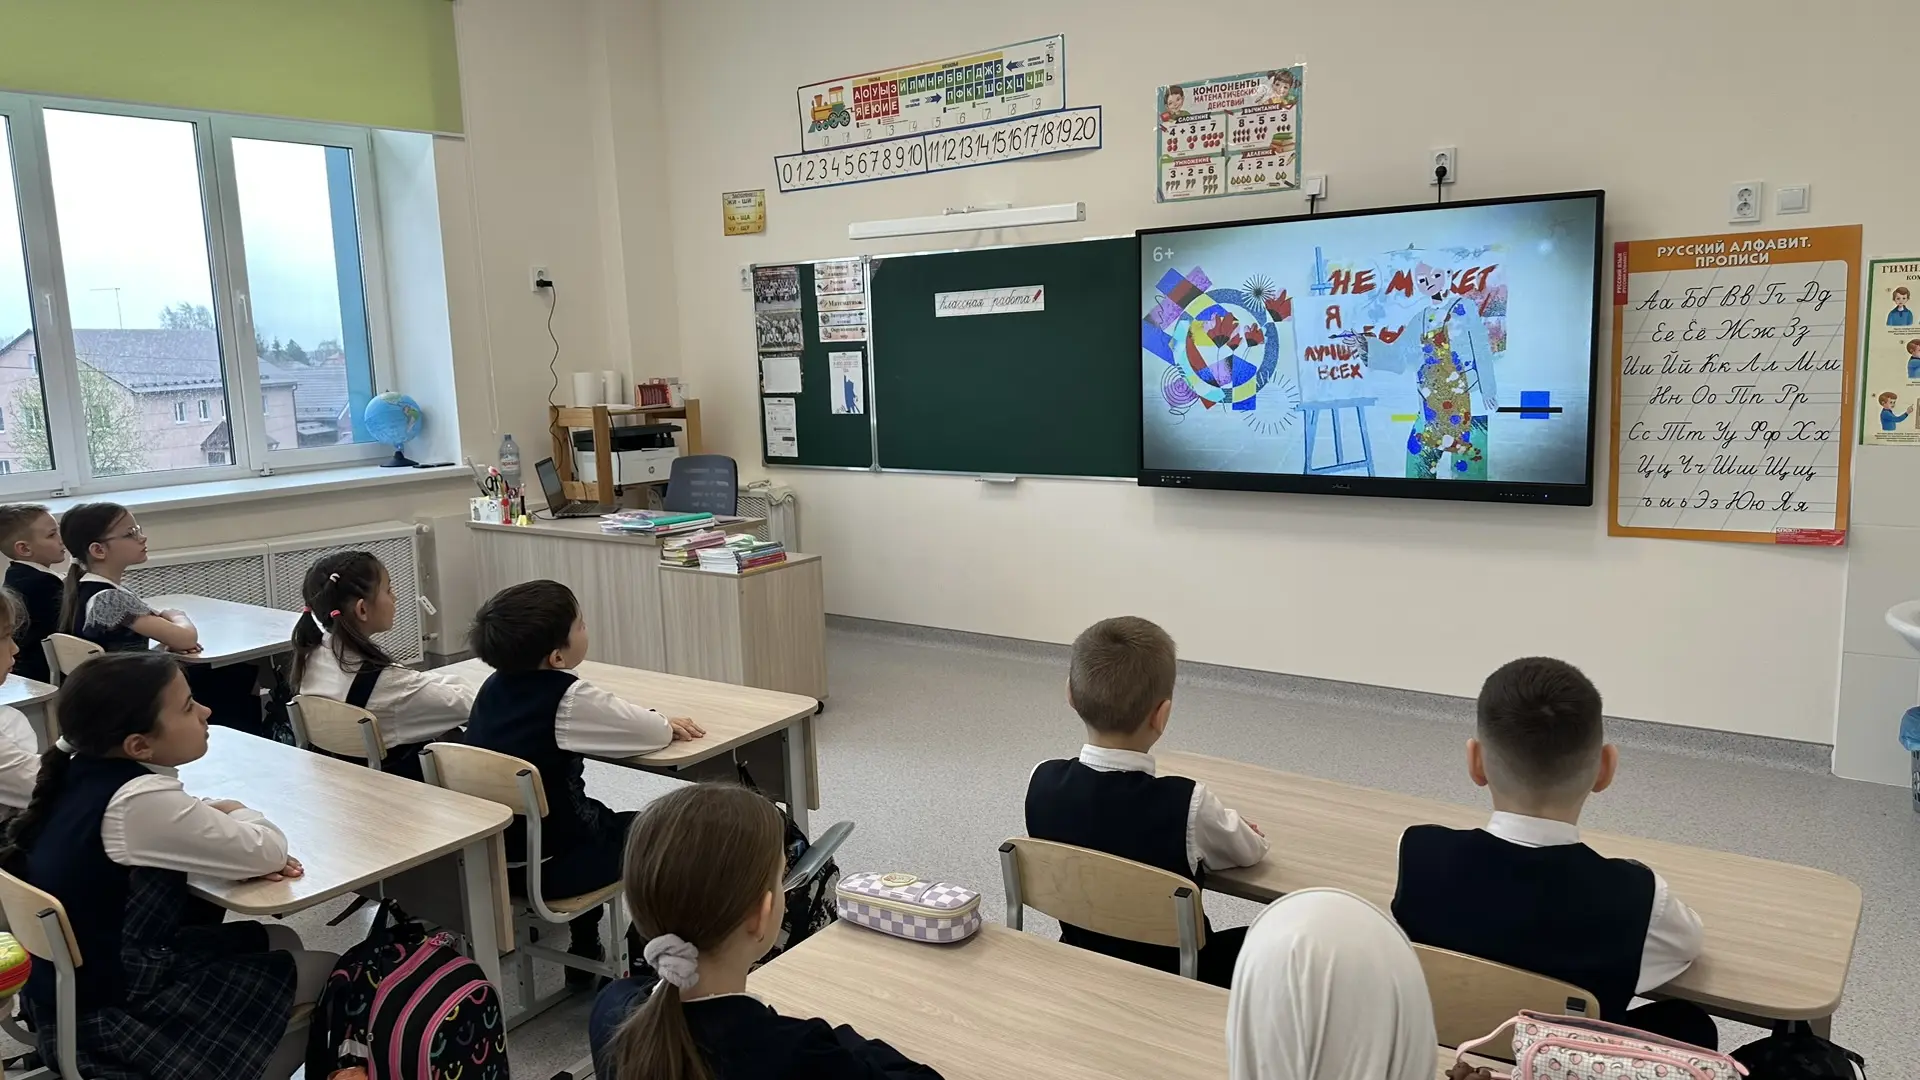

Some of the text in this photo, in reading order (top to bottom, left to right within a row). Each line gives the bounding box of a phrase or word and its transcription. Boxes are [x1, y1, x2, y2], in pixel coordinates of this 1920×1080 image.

[1193, 79, 1259, 95] КОМПОНЕНТЫ
[1194, 88, 1258, 102] МАТЕМАТИЧЕСКИХ
[1244, 105, 1280, 113] ВЫЧИТАНИЕ
[1170, 128, 1175, 136] 4
[1211, 123, 1216, 131] 7
[1239, 119, 1244, 127] 8
[1259, 116, 1264, 124] 5
[1281, 114, 1287, 122] 3
[783, 117, 1096, 183] 0 1 2 3 4 5 6 7 8 9 10 11 12 13 14 15 16 17 18 19 20
[1176, 157, 1209, 166] УМНОЖЕНИЕ
[1257, 161, 1262, 169] 2
[1279, 158, 1284, 166] 2
[1171, 170, 1176, 178] 3
[1153, 246, 1174, 262] 6+
[1657, 236, 1811, 257] РУССКИЙ АЛФАВИТ.
[1695, 252, 1769, 268] ПРОПИСИ
[1882, 264, 1920, 273] ГИМН
[1328, 264, 1499, 298] НЕ МЕТ
[940, 290, 1032, 312] Классная работа
[1636, 290, 1674, 310] Аа
[1681, 286, 1723, 308] Бб
[1720, 284, 1755, 306] Вв
[1759, 282, 1786, 304] Гг
[1326, 305, 1342, 329] Я
[1652, 317, 1810, 347] Ее Ёё Жж Зз
[1318, 363, 1363, 380] ВСЕХ
[1623, 355, 1654, 375] Ии
[1661, 351, 1693, 374] Йй
[1700, 353, 1730, 373] Кк
[1737, 352, 1778, 371] Лл
[1649, 383, 1808, 410] Нн Оо Пп Рр
[1628, 420, 1830, 449] Сс Тт Уу Фф Хх
[1637, 454, 1672, 478] Цц
[1712, 454, 1758, 474] Шш
[1694, 490, 1718, 509] Ээ
[1725, 490, 1764, 510] Юю
